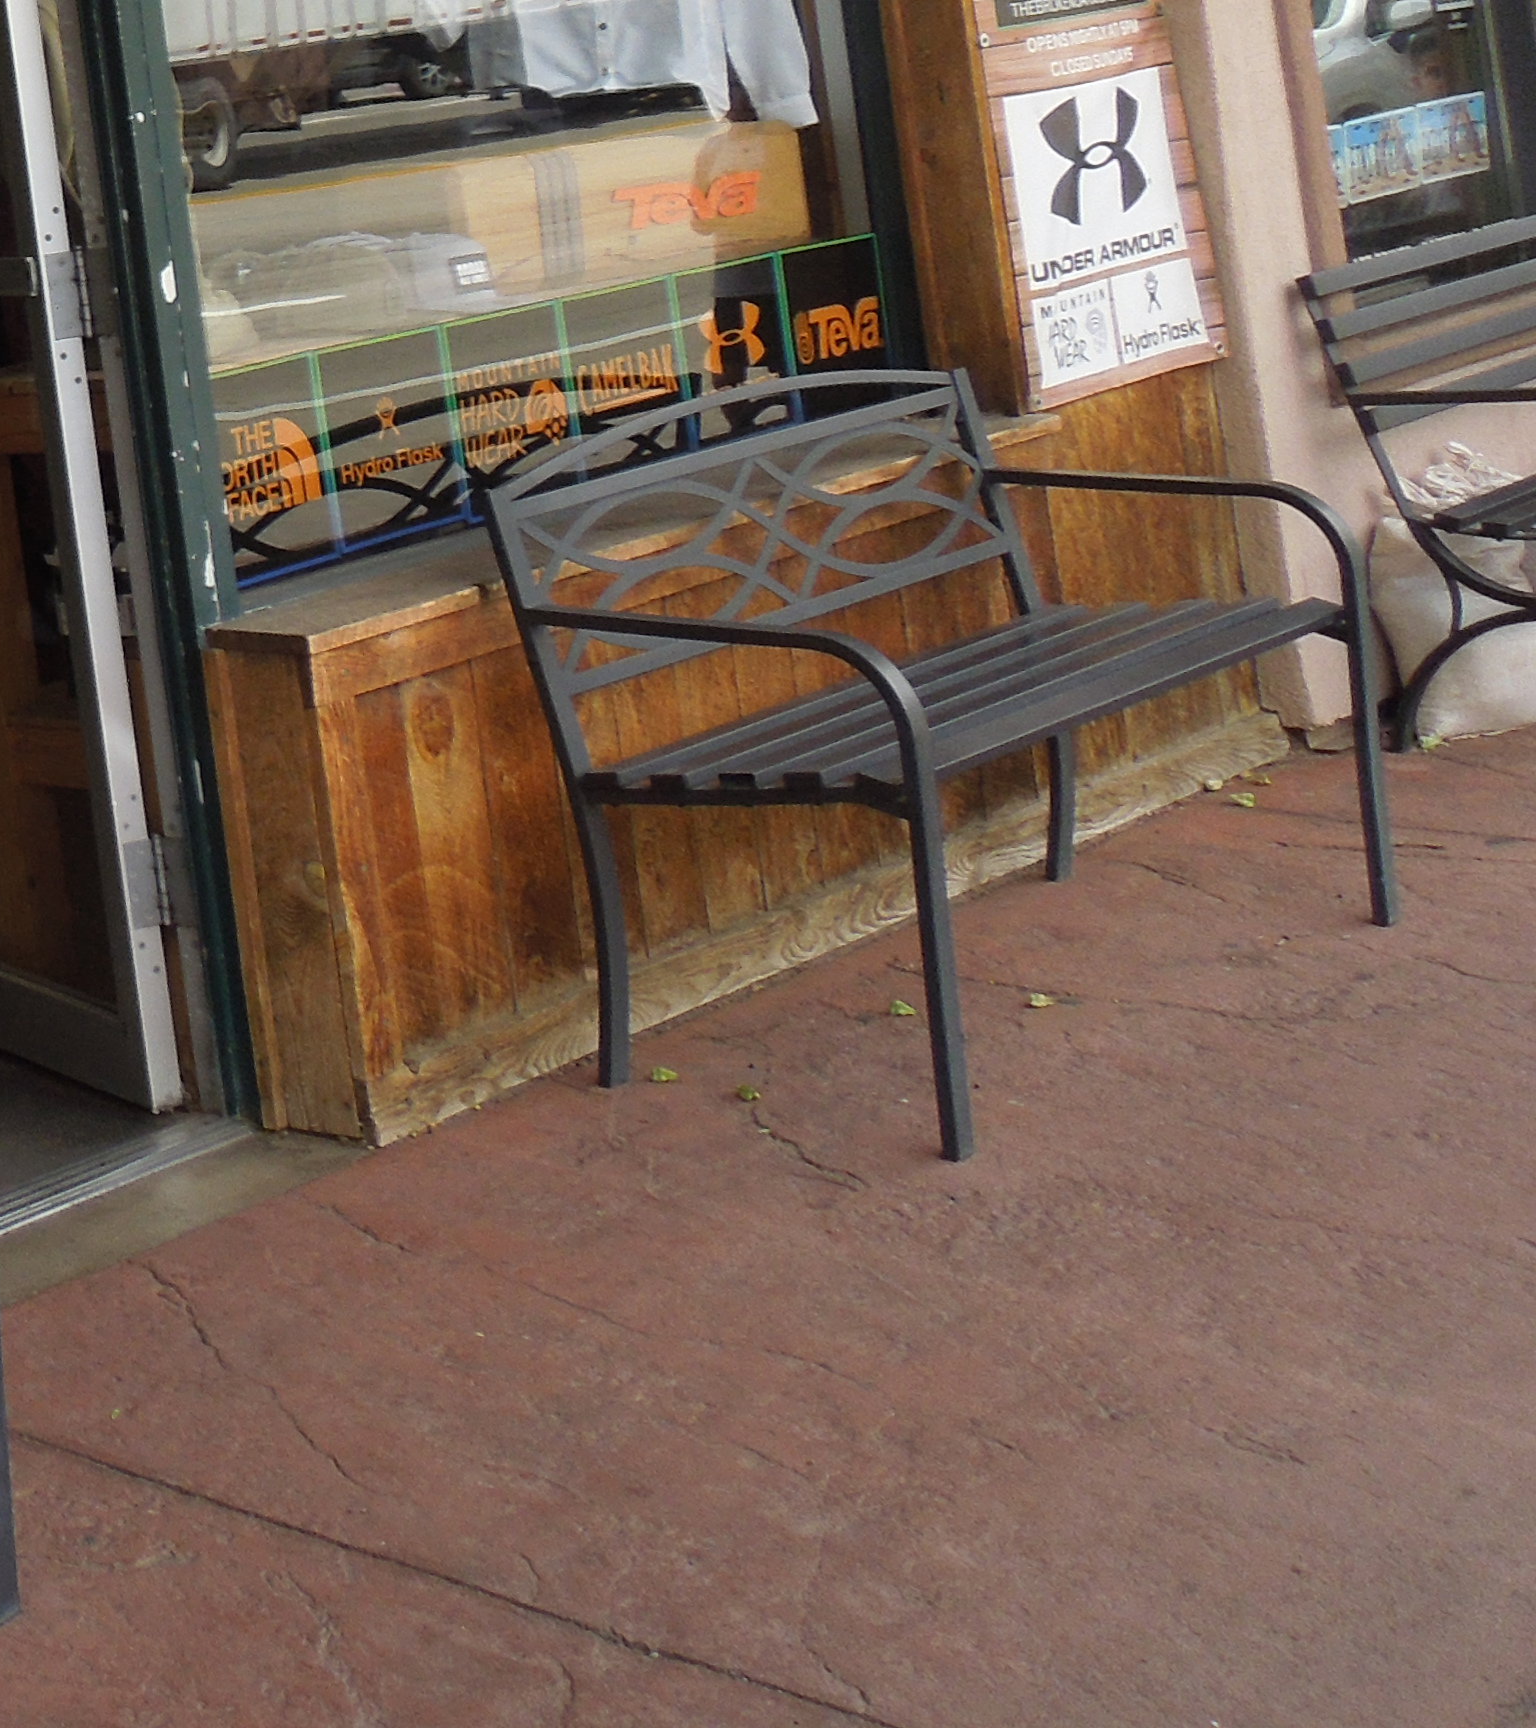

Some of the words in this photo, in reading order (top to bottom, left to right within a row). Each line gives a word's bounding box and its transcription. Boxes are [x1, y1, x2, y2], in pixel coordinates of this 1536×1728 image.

[612, 170, 762, 230] Teva
[1031, 248, 1096, 283] UNDER
[1098, 226, 1176, 264] ARMOUR
[809, 295, 881, 360] Teva
[1123, 329, 1160, 358] Hydro
[1160, 317, 1201, 343] Flask
[456, 354, 561, 391] MOUNTAIN
[578, 343, 679, 415] CAMELBAK
[458, 387, 521, 432] HARD
[230, 420, 274, 454] THE
[464, 424, 528, 469] WEAR
[221, 450, 281, 490] ORTH
[341, 457, 395, 488] Hydro
[396, 442, 444, 469] Flask
[228, 480, 283, 523] FACE
